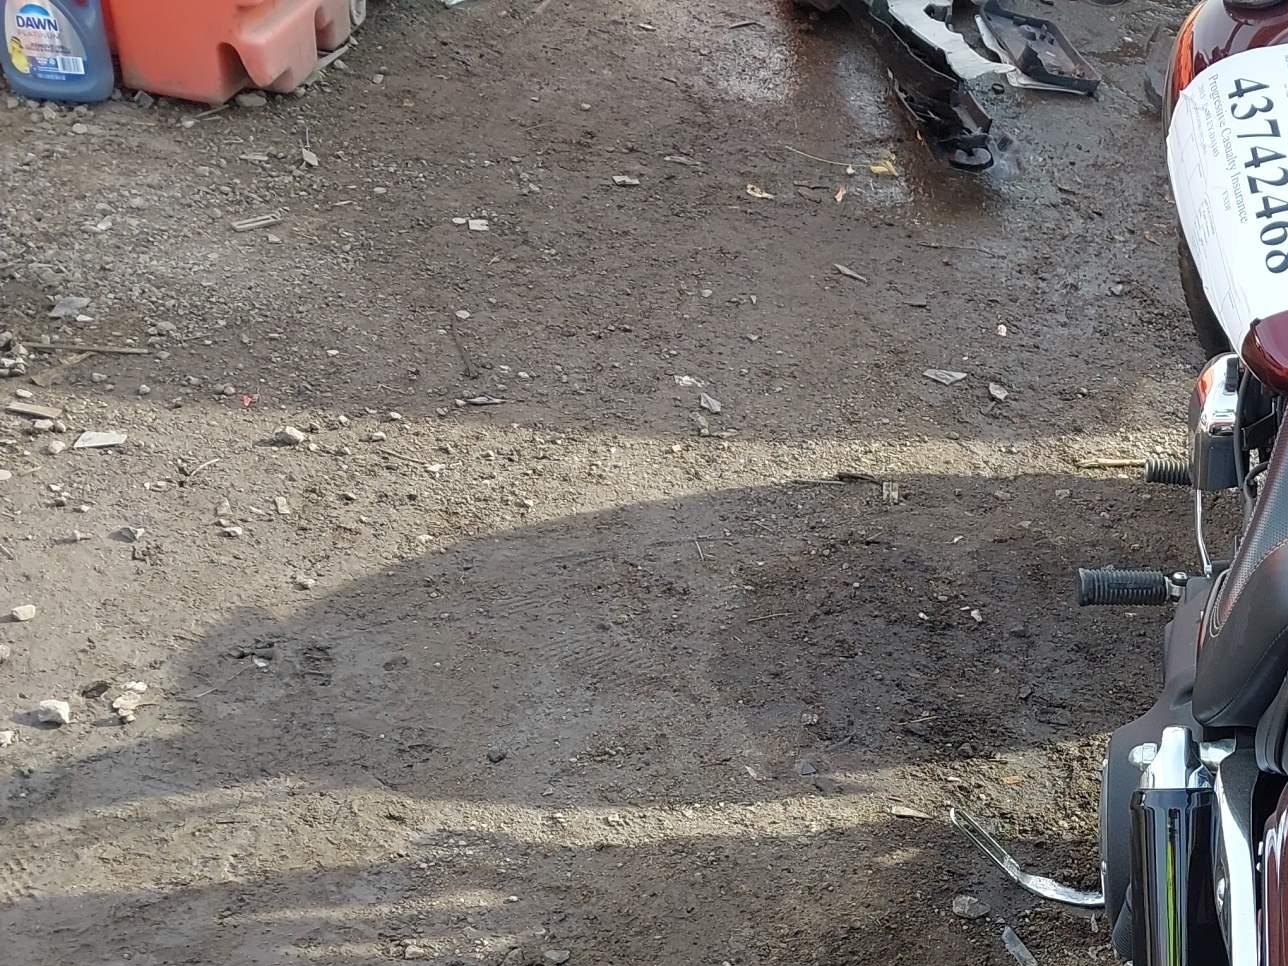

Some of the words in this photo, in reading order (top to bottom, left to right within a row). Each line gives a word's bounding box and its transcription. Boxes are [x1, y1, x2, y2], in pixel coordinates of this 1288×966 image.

[16, 15, 58, 31] DAWN
[1208, 74, 1226, 127] Progressive
[1221, 128, 1238, 171] Casualty
[1231, 172, 1248, 223] Insurance
